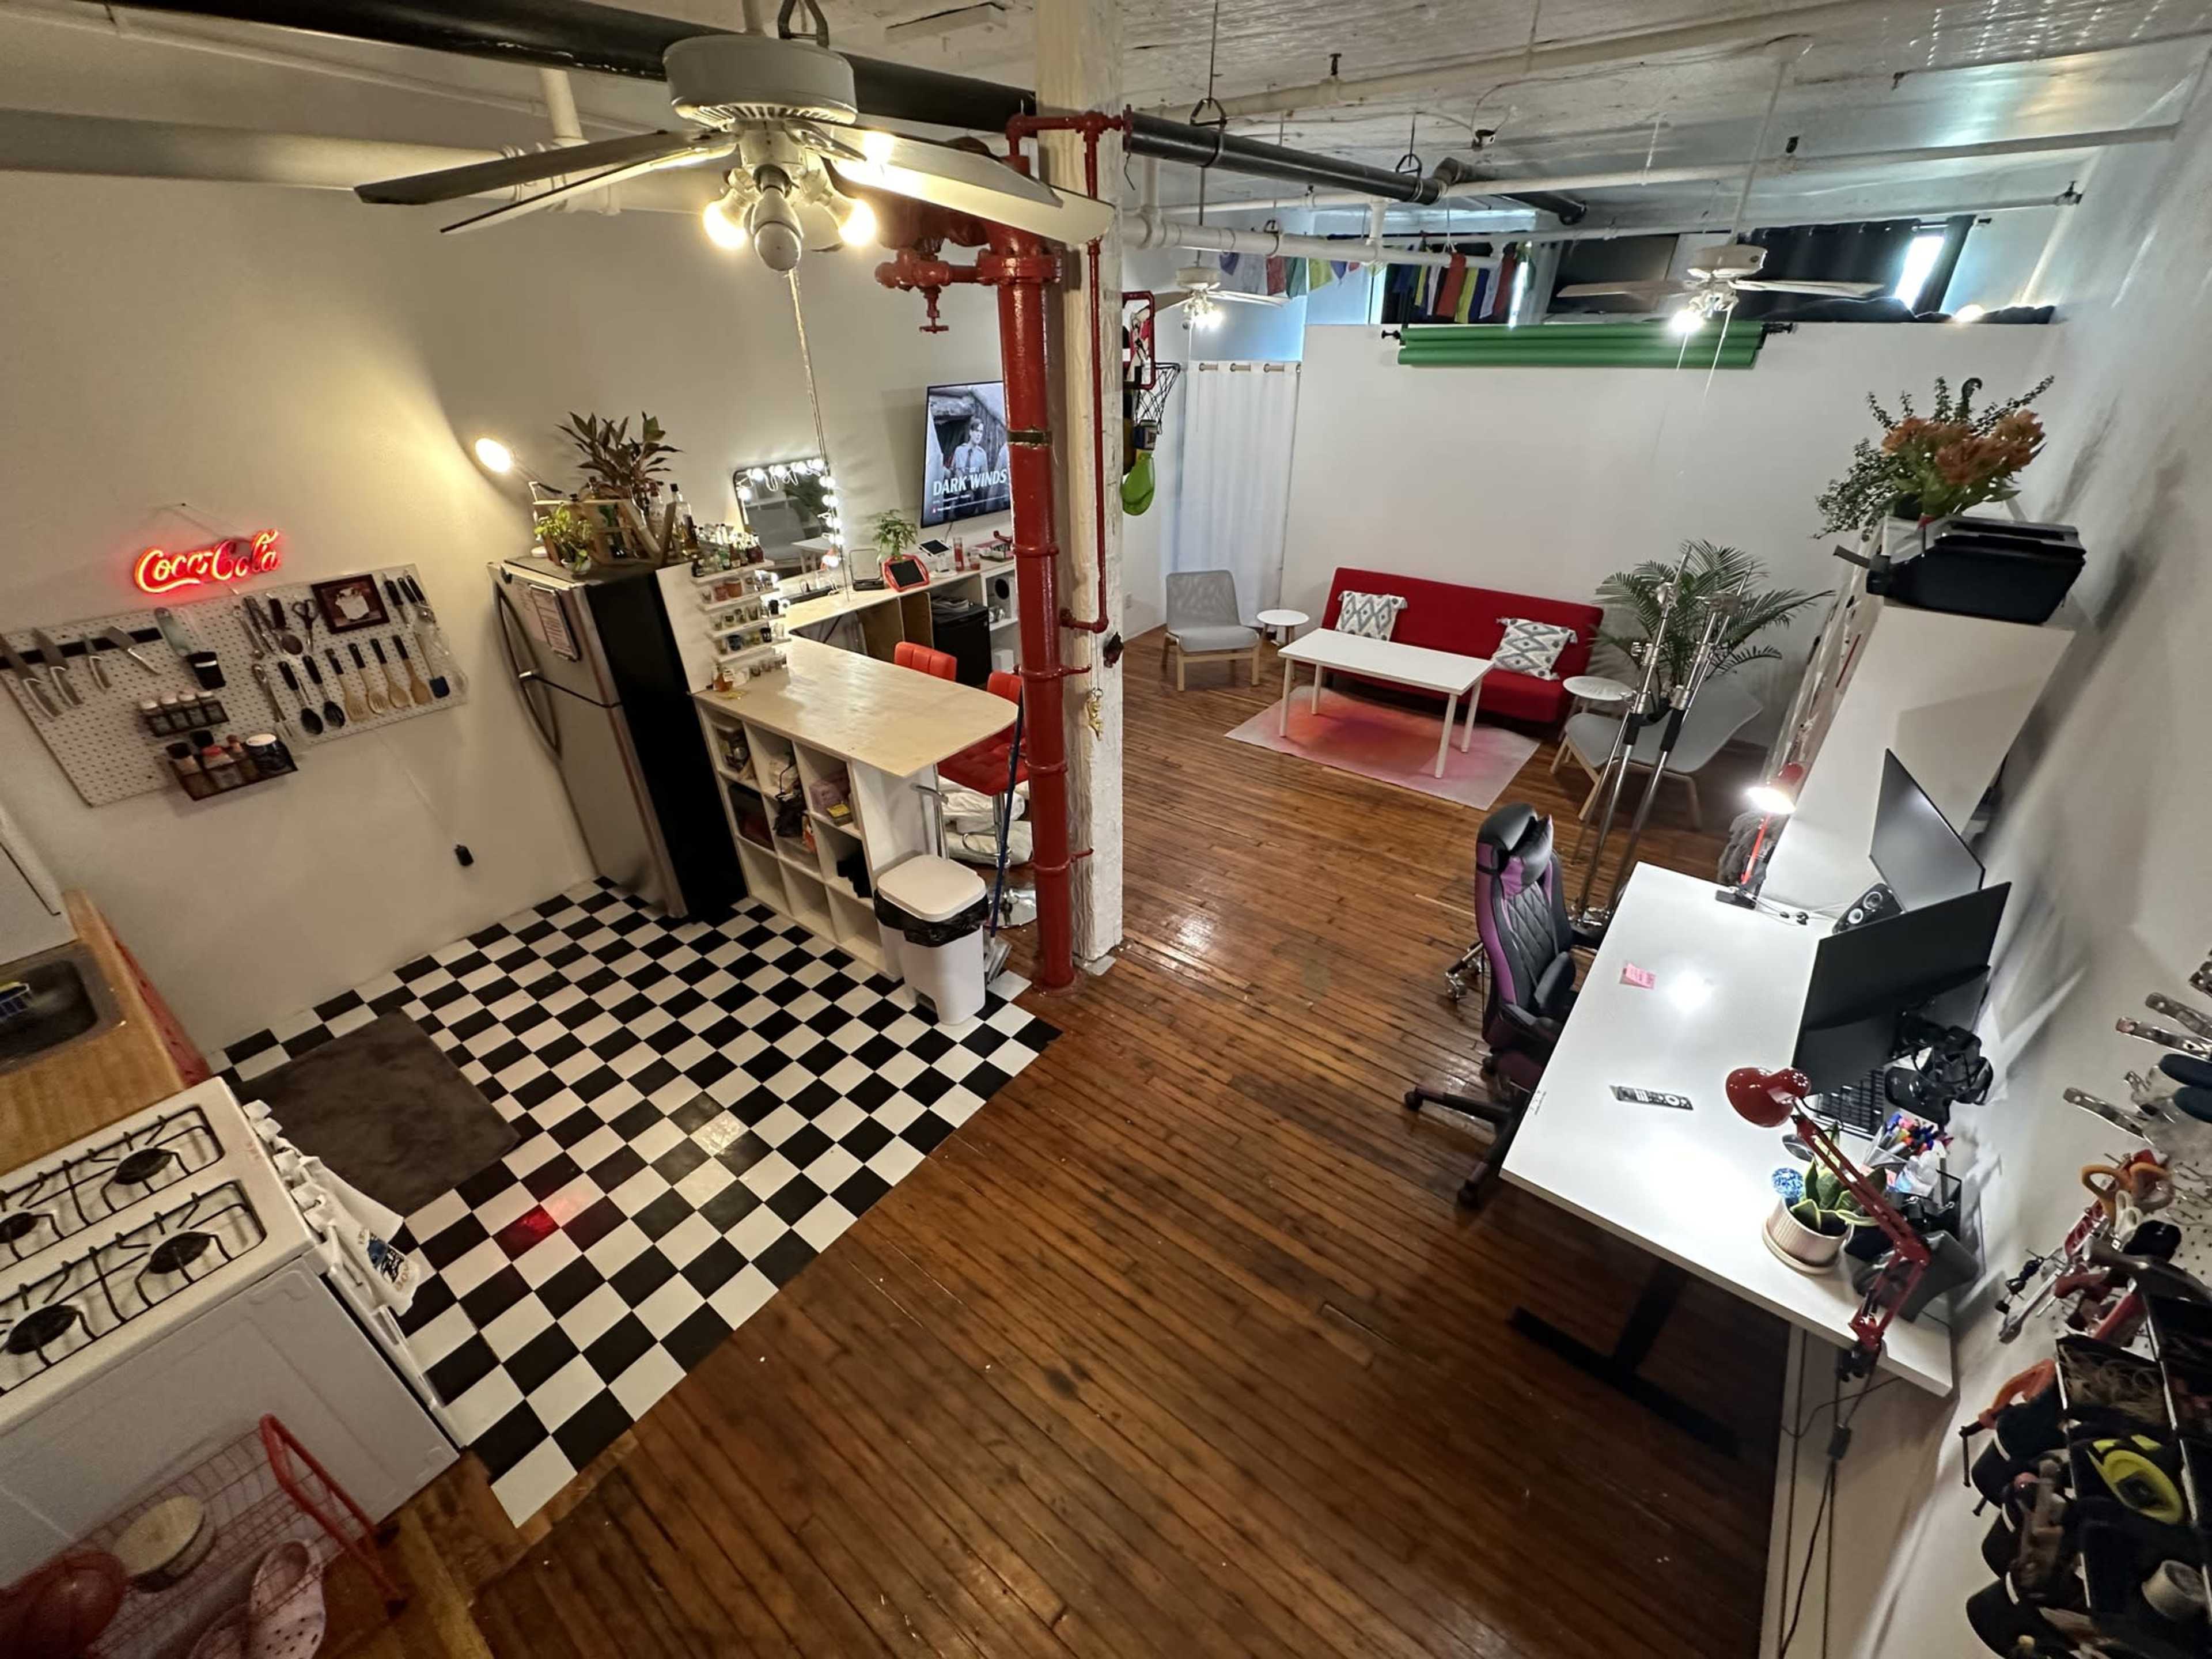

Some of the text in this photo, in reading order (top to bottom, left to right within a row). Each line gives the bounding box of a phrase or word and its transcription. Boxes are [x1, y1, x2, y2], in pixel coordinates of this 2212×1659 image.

[933, 468, 1007, 496] DARK WINDS
[137, 528, 280, 593] Coca-Cola
